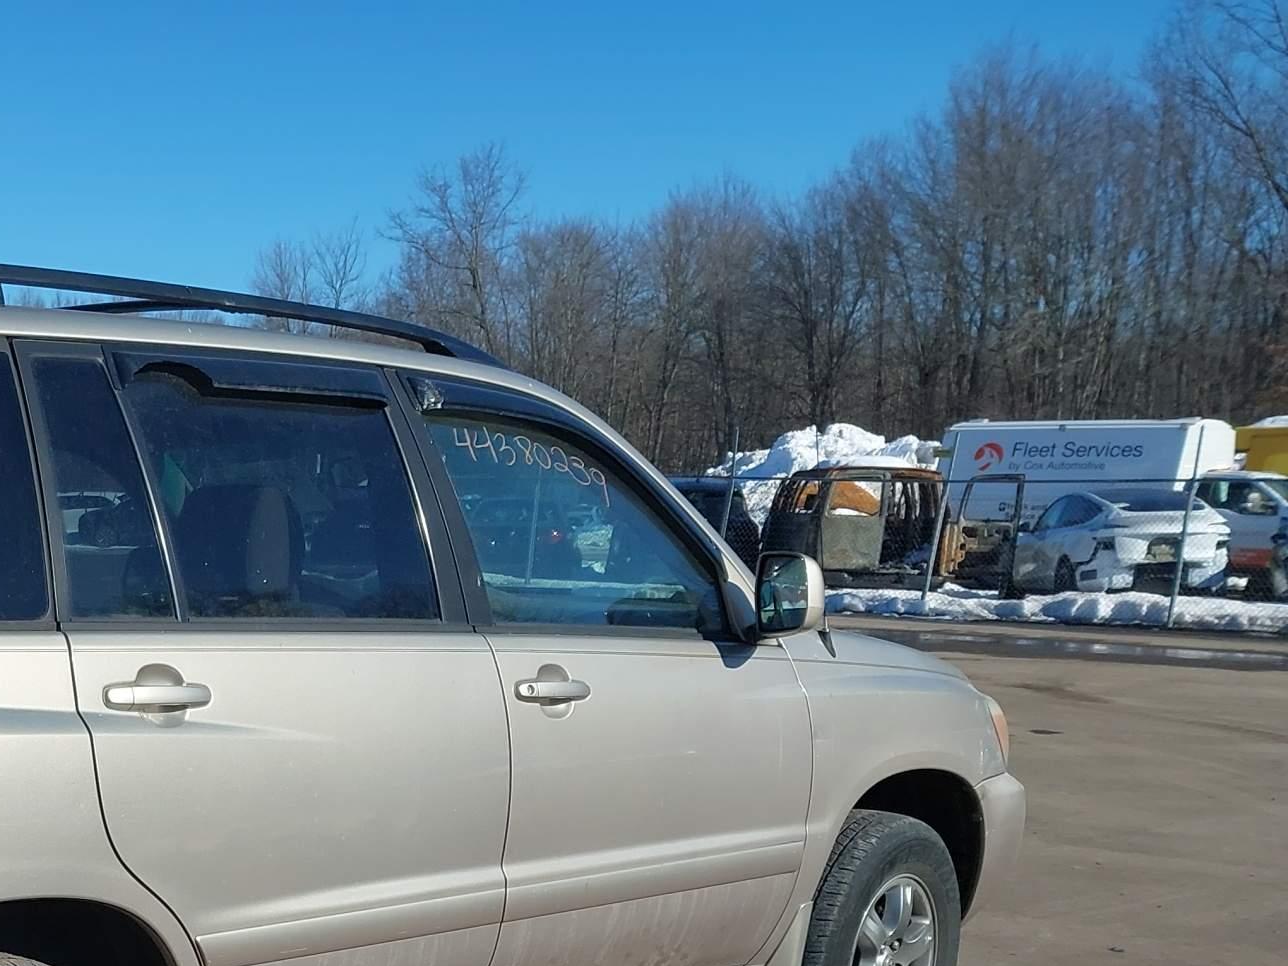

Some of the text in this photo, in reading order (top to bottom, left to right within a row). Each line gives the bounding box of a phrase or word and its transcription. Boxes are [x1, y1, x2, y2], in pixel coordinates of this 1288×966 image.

[1012, 441, 1143, 458] Fleet Services
[452, 426, 610, 507] 44380239
[1008, 461, 1106, 472] by Cox Automotive
